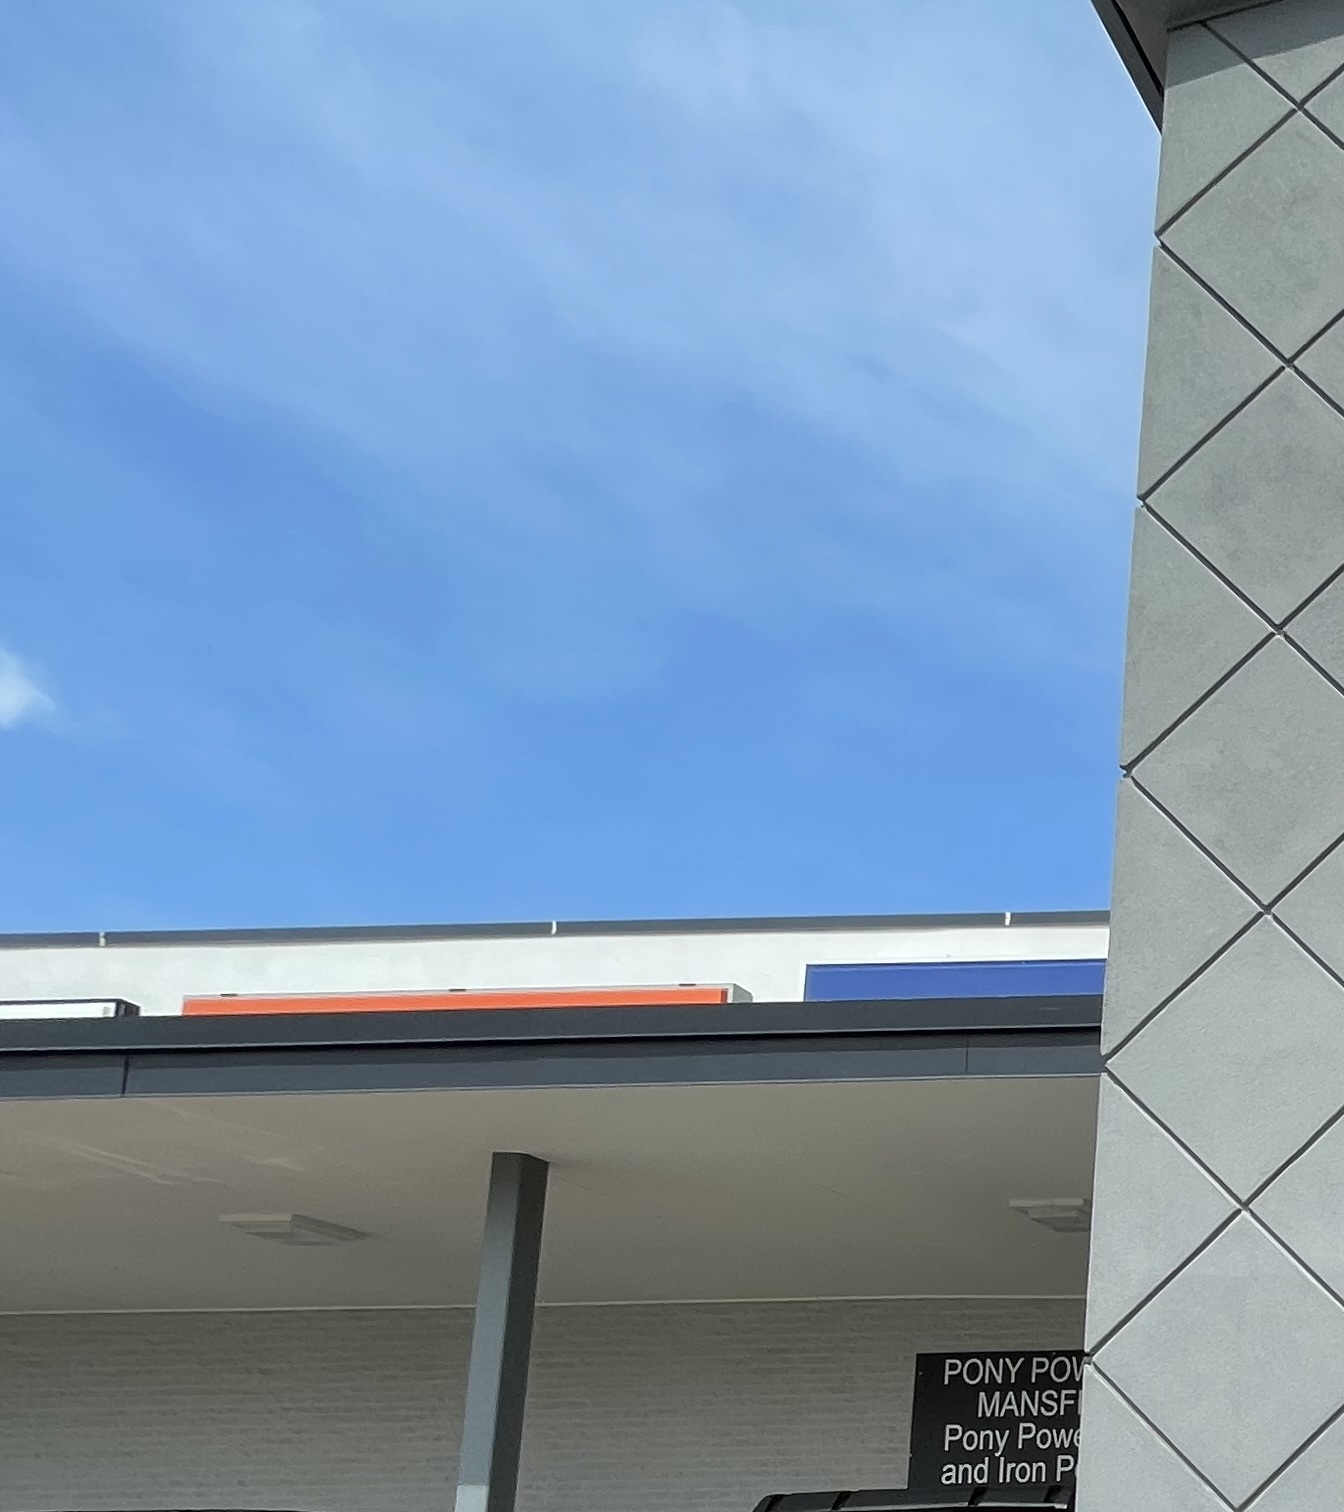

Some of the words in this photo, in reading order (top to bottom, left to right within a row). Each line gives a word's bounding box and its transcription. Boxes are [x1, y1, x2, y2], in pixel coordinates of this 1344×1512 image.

[943, 1357, 1025, 1385] PONY
[944, 1423, 1010, 1457] Pony
[941, 1456, 989, 1485] and
[998, 1456, 1046, 1484] Iron
